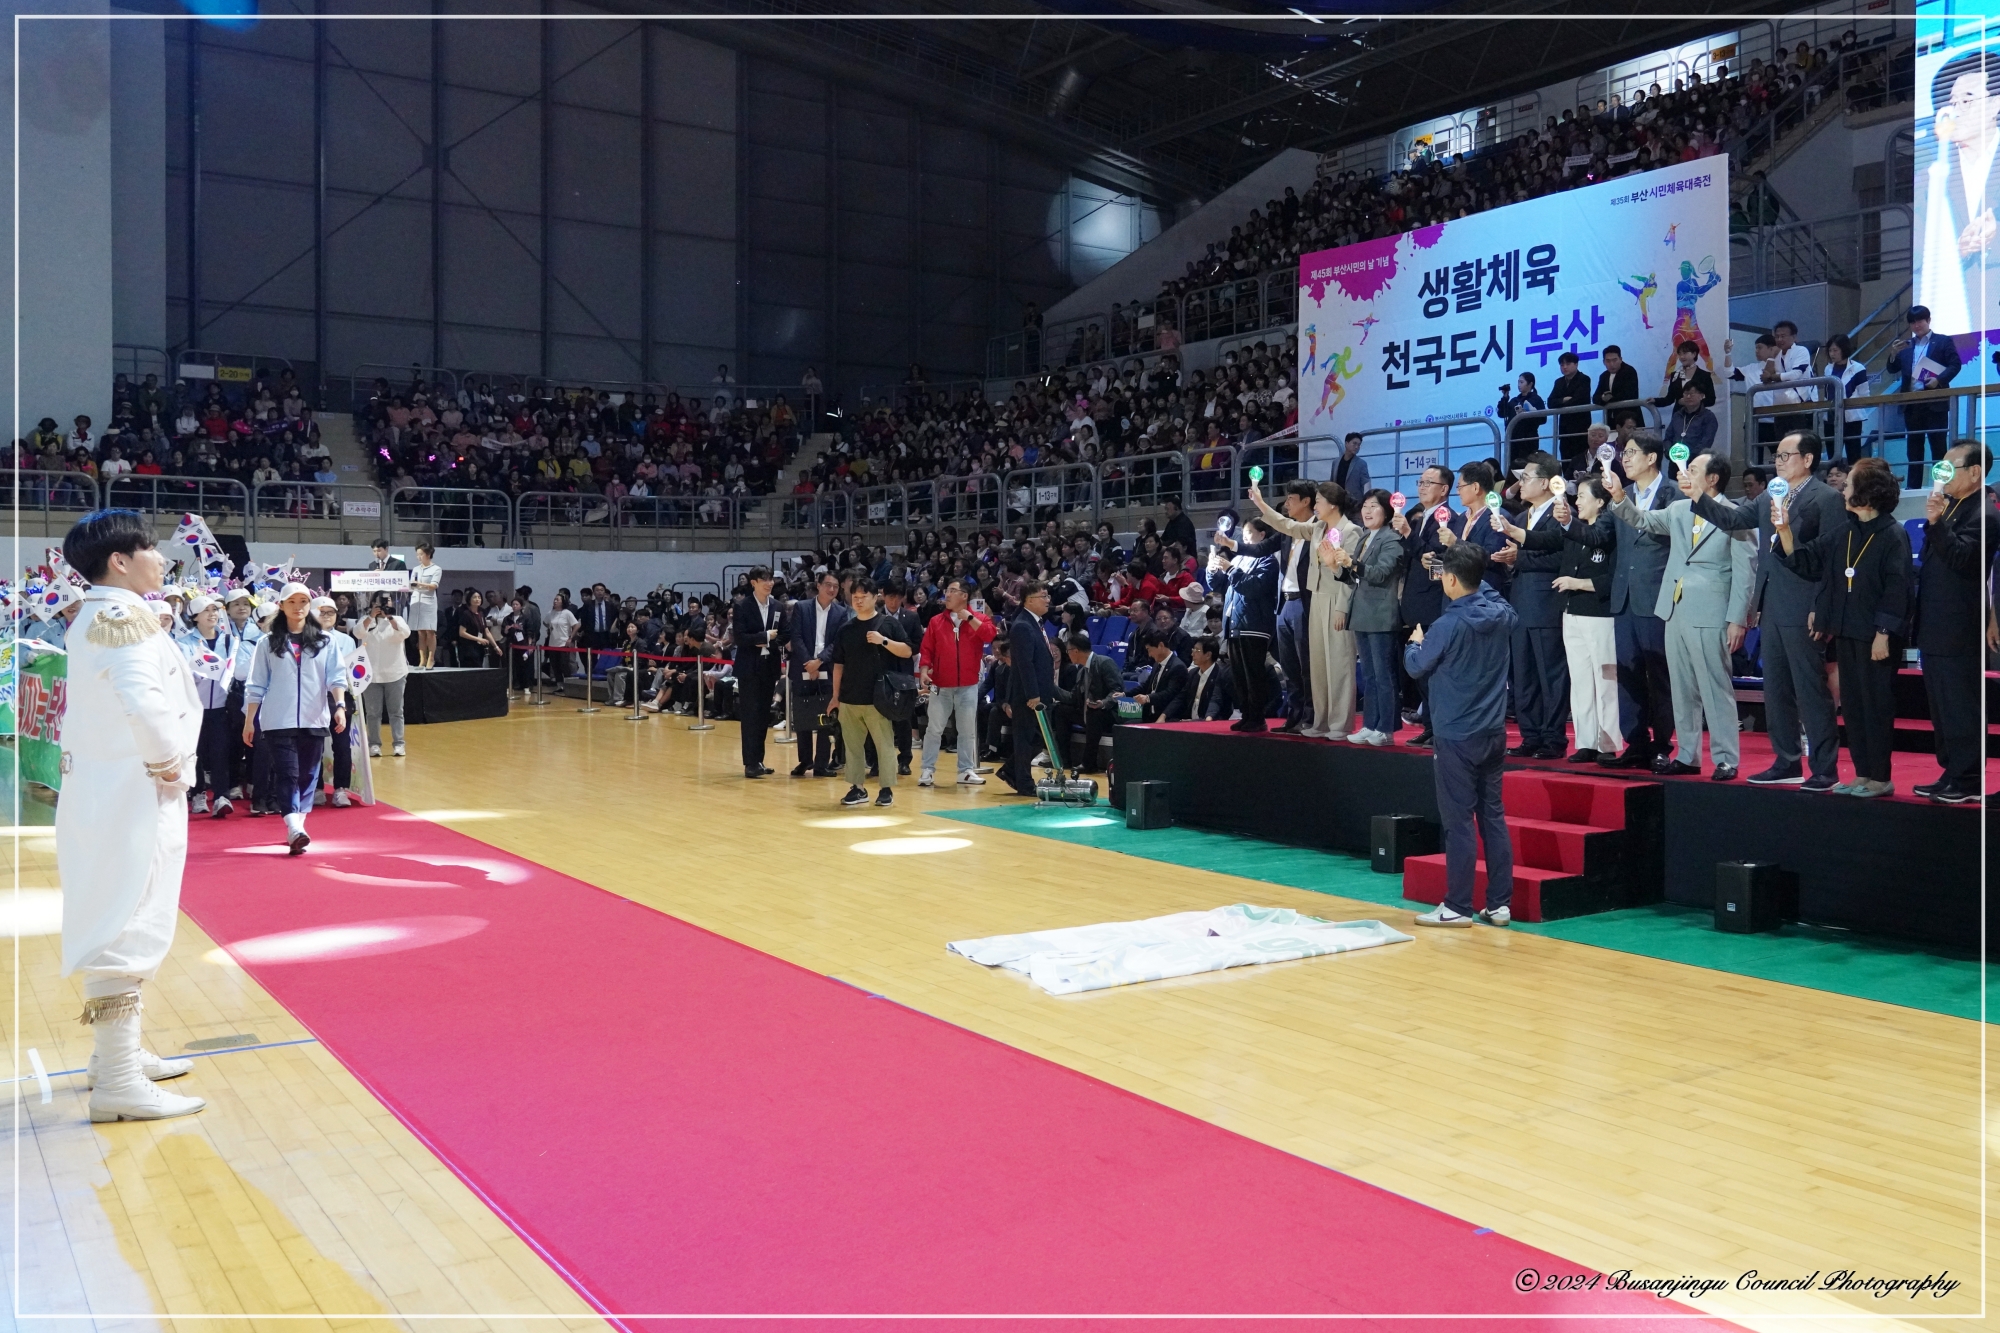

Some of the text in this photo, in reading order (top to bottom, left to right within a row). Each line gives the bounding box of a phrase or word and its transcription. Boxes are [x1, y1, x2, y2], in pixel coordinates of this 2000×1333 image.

[1609, 173, 1711, 206] 제35회 부산 시민체육대축전
[1310, 255, 1390, 281] 제45회 부산시민의 날 기념
[1418, 243, 1560, 319] 생활체육
[1382, 304, 1605, 391] 천국도시 부산
[219, 369, 238, 379] 2-20
[351, 578, 362, 586] 부산
[363, 577, 403, 586] 시민체육대축전
